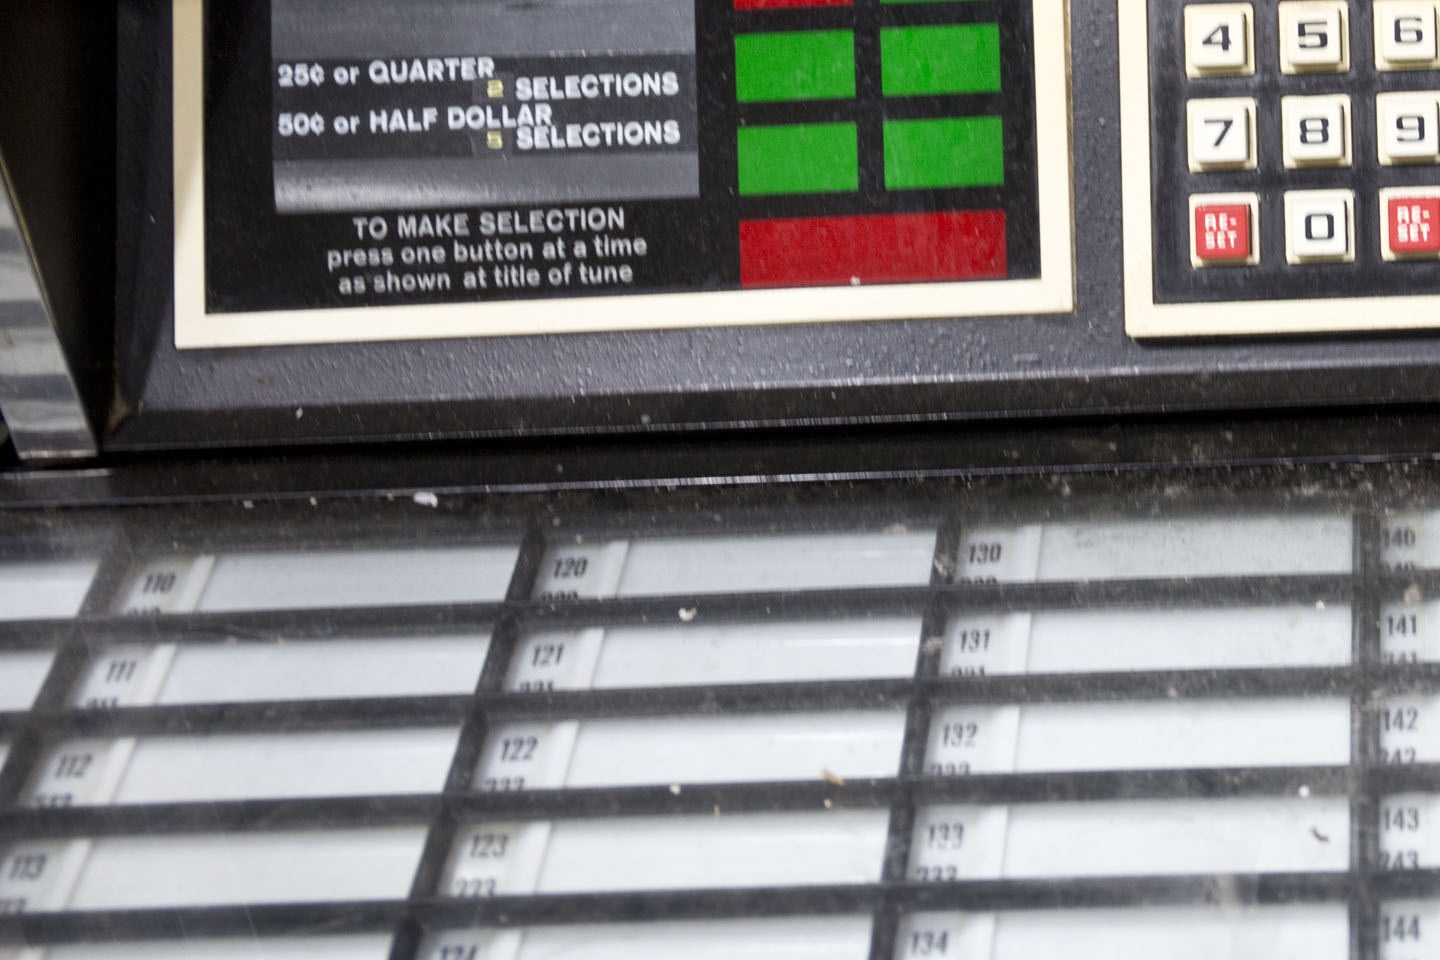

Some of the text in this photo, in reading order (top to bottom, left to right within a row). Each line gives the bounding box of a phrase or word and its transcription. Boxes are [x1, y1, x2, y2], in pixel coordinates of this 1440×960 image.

[1201, 25, 1232, 52] 4
[1297, 21, 1329, 49] 5
[1393, 17, 1424, 43] 6
[278, 56, 496, 87] 25¢ or QUARTER
[515, 71, 679, 101] SELECTIONS
[278, 103, 552, 136] 50¢ or HALF DOLLAR
[1203, 119, 1234, 147] 7
[1299, 117, 1330, 145] 8
[1396, 115, 1426, 142] 9
[516, 120, 681, 150] SELECTIONS
[352, 206, 625, 240] TO MAKE SELECTION
[1304, 213, 1335, 240] 0
[1397, 223, 1430, 243] SET
[327, 234, 648, 273] press one button at a time
[1204, 231, 1238, 250] SET
[338, 261, 633, 295] as shown at title of tune
[968, 542, 1002, 565] 130
[554, 556, 588, 579] 120
[1387, 614, 1417, 636] 141
[960, 628, 991, 653] 131
[532, 643, 564, 667] 121
[105, 660, 137, 683] 111
[1383, 708, 1418, 731] 142
[942, 722, 978, 749] 132
[501, 736, 539, 763] 122
[1384, 807, 1419, 831] 143
[470, 833, 508, 858] 123
[927, 822, 964, 850] 133
[1383, 914, 1420, 943] 144
[911, 929, 949, 956] 134
